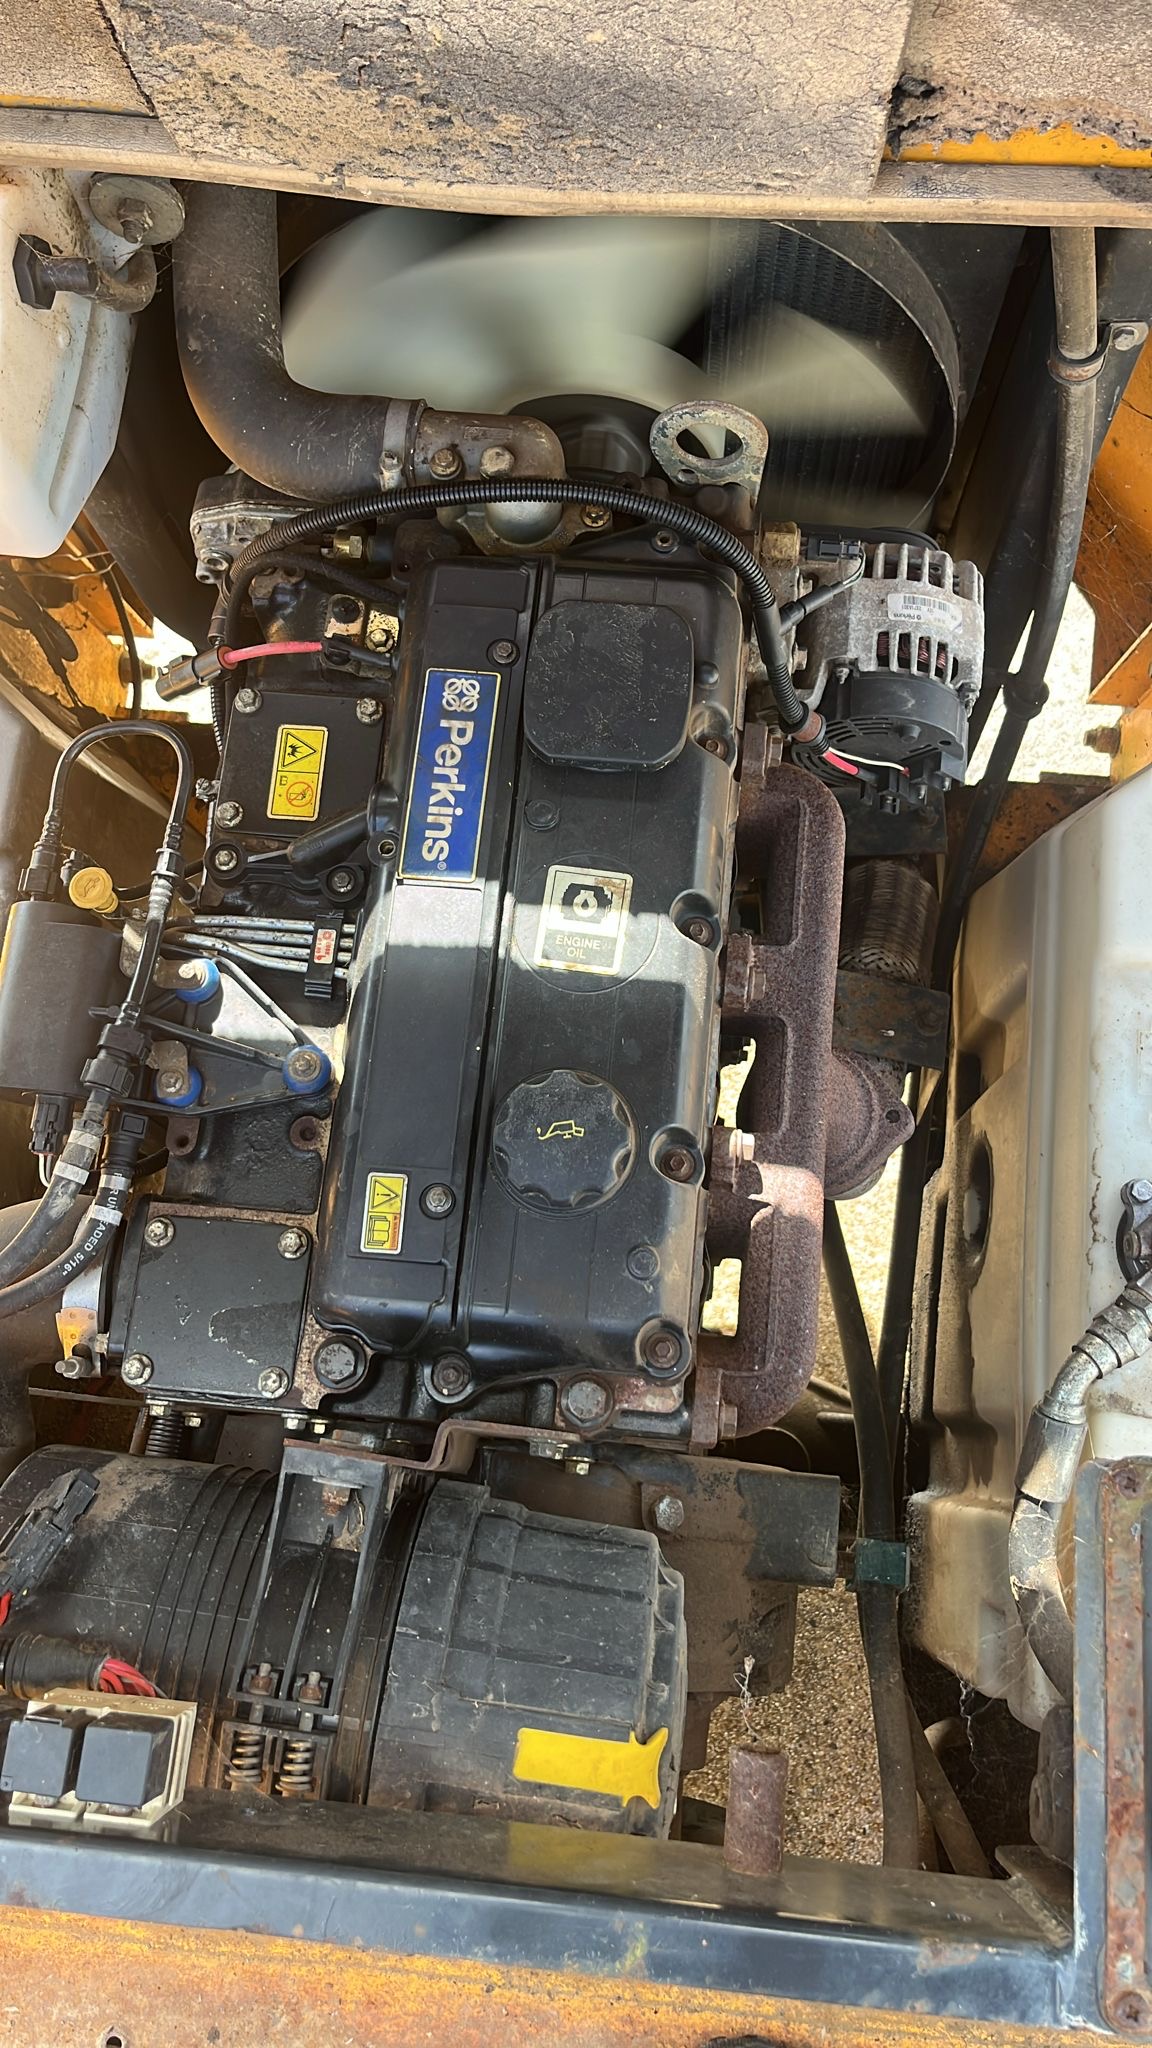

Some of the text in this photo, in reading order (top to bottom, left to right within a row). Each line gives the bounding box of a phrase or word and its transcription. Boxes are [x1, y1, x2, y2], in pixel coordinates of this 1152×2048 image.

[555, 934, 601, 950] ENGINE
[566, 946, 587, 959] OIL
[84, 1196, 118, 1252] UNEADED
